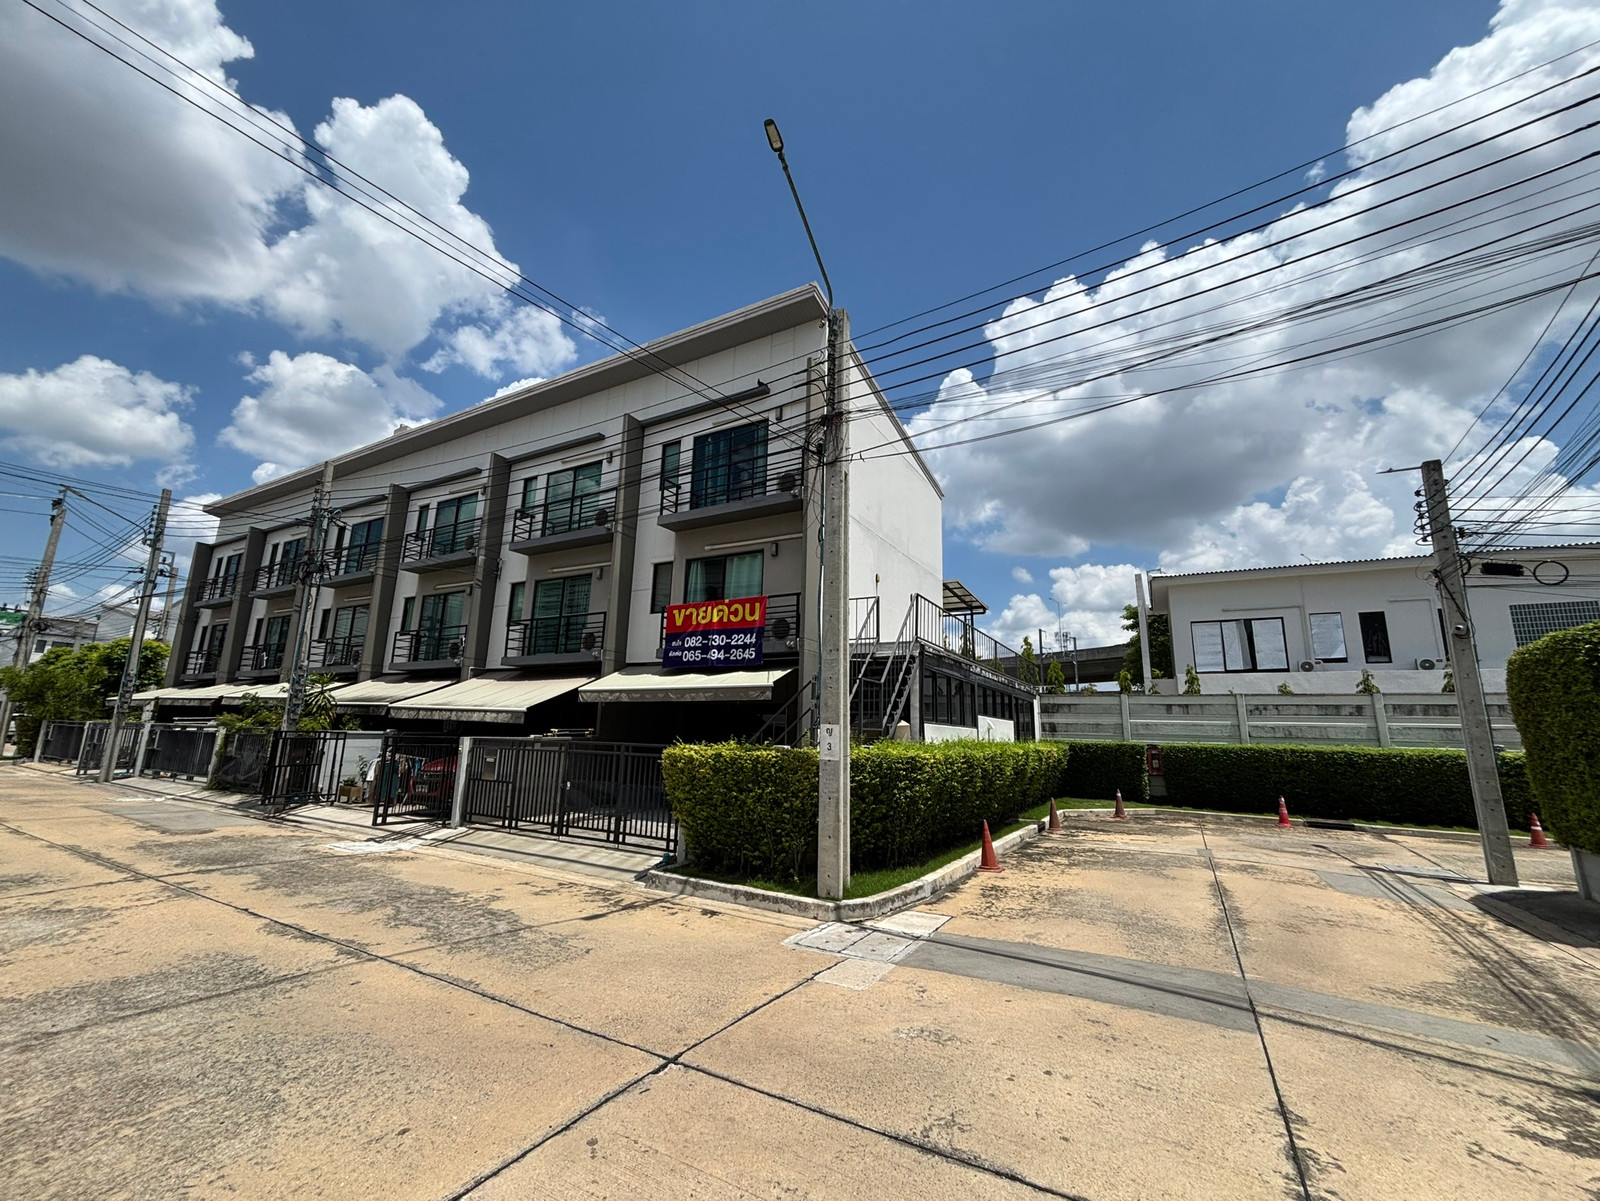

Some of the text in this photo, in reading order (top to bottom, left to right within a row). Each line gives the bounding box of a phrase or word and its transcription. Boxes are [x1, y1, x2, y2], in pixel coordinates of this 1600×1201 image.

[673, 599, 760, 626] ขายด่วน
[826, 742, 832, 751] 3
